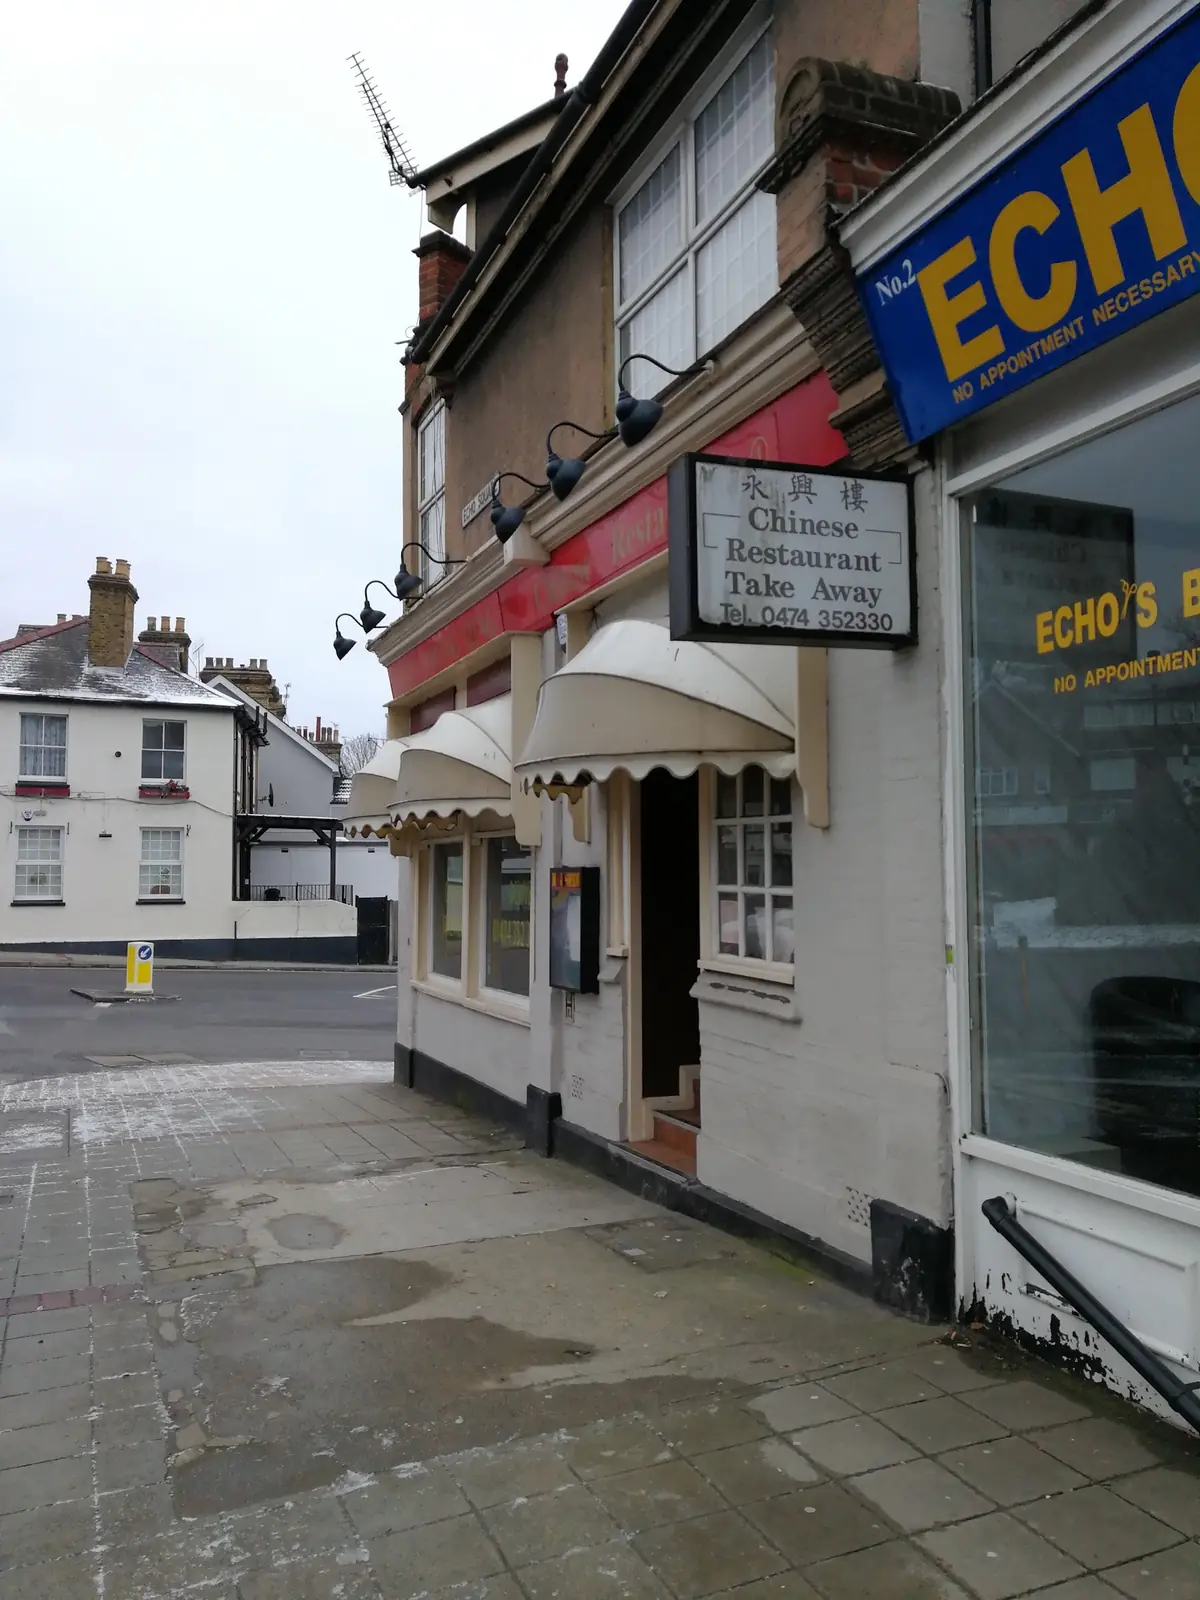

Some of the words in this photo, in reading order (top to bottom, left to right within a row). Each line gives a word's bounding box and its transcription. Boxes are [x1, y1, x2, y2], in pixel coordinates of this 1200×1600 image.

[874, 258, 917, 307] No.2
[952, 381, 974, 405] NO
[980, 315, 1084, 391] APPOINTMENT
[748, 506, 860, 540] Chinese
[725, 538, 882, 573] Restaurant
[724, 571, 796, 599] Take
[811, 577, 883, 609] Away
[719, 602, 752, 625] Tel.
[761, 605, 810, 628] 0474
[818, 609, 893, 632] 352330
[1053, 675, 1077, 695] NO
[1084, 646, 1200, 689] APPOINTMEN
